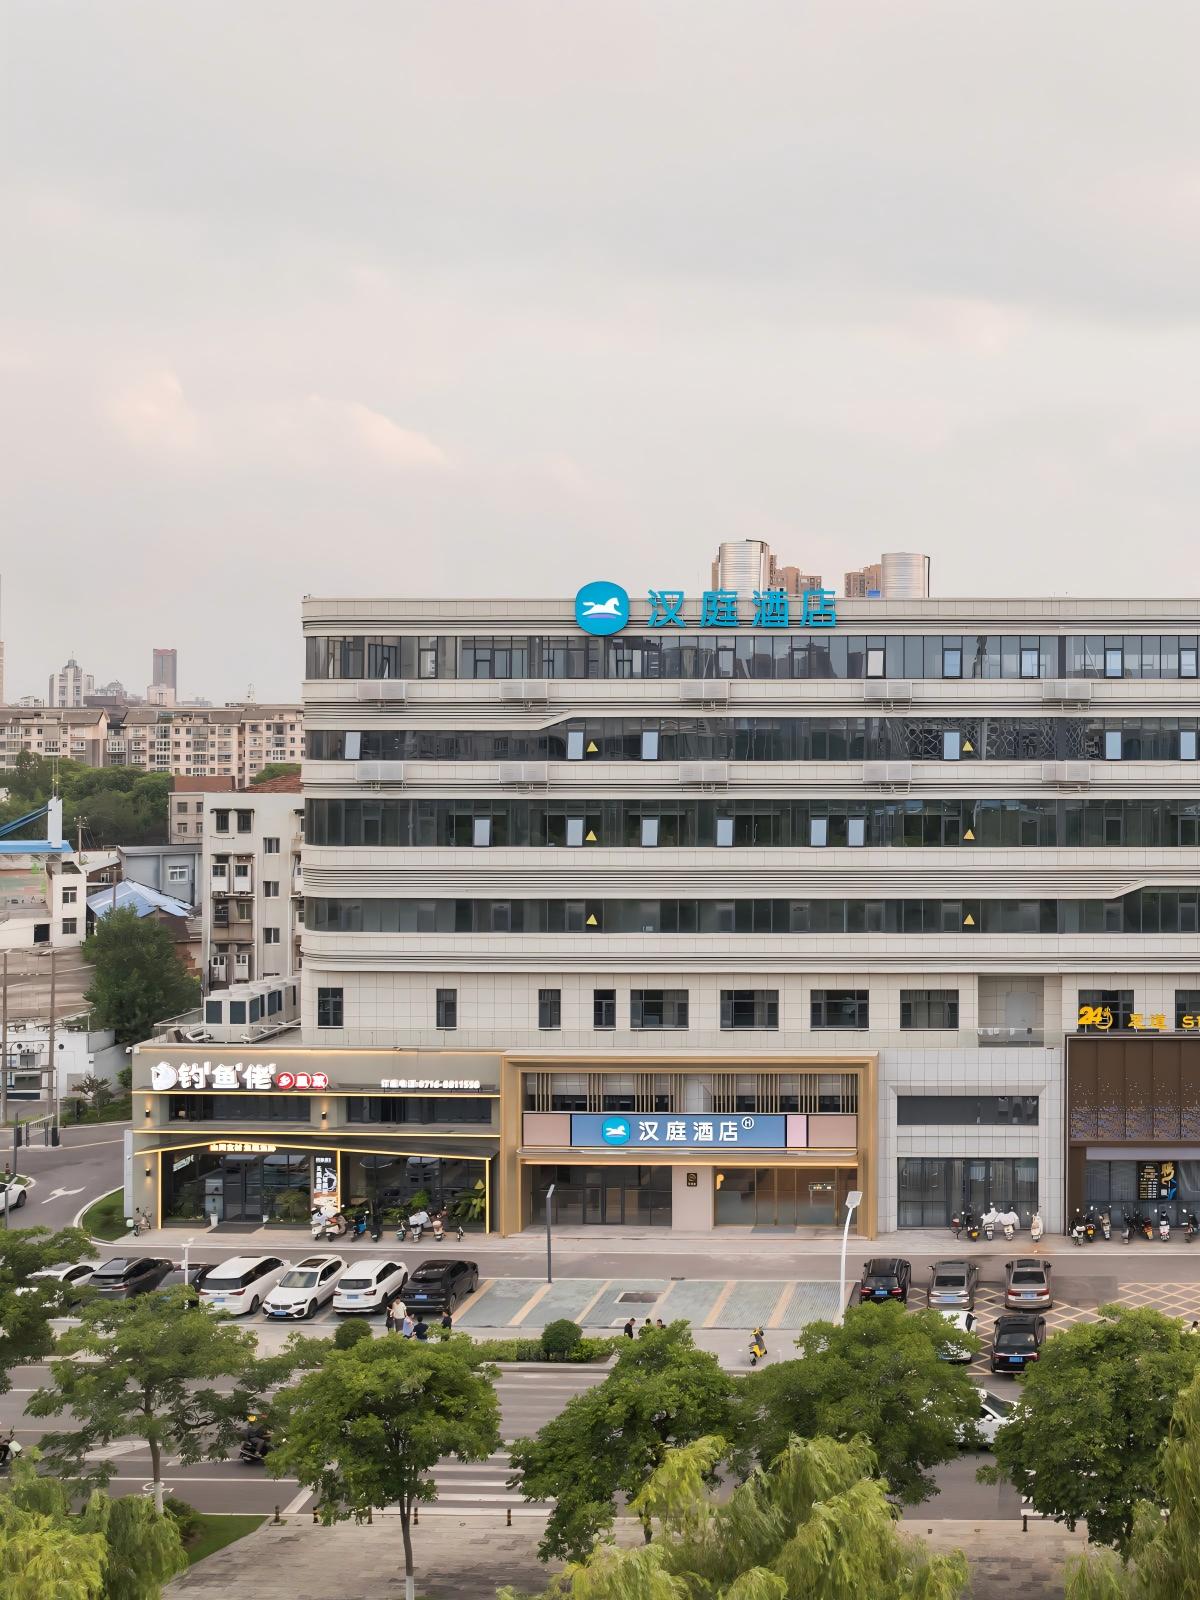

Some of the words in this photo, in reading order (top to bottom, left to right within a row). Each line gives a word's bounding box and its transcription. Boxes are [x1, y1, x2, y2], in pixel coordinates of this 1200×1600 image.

[647, 588, 836, 628] 汉庭酒店
[178, 1061, 276, 1089] 钓鱼佬
[639, 1120, 738, 1142] 汉庭酒店
